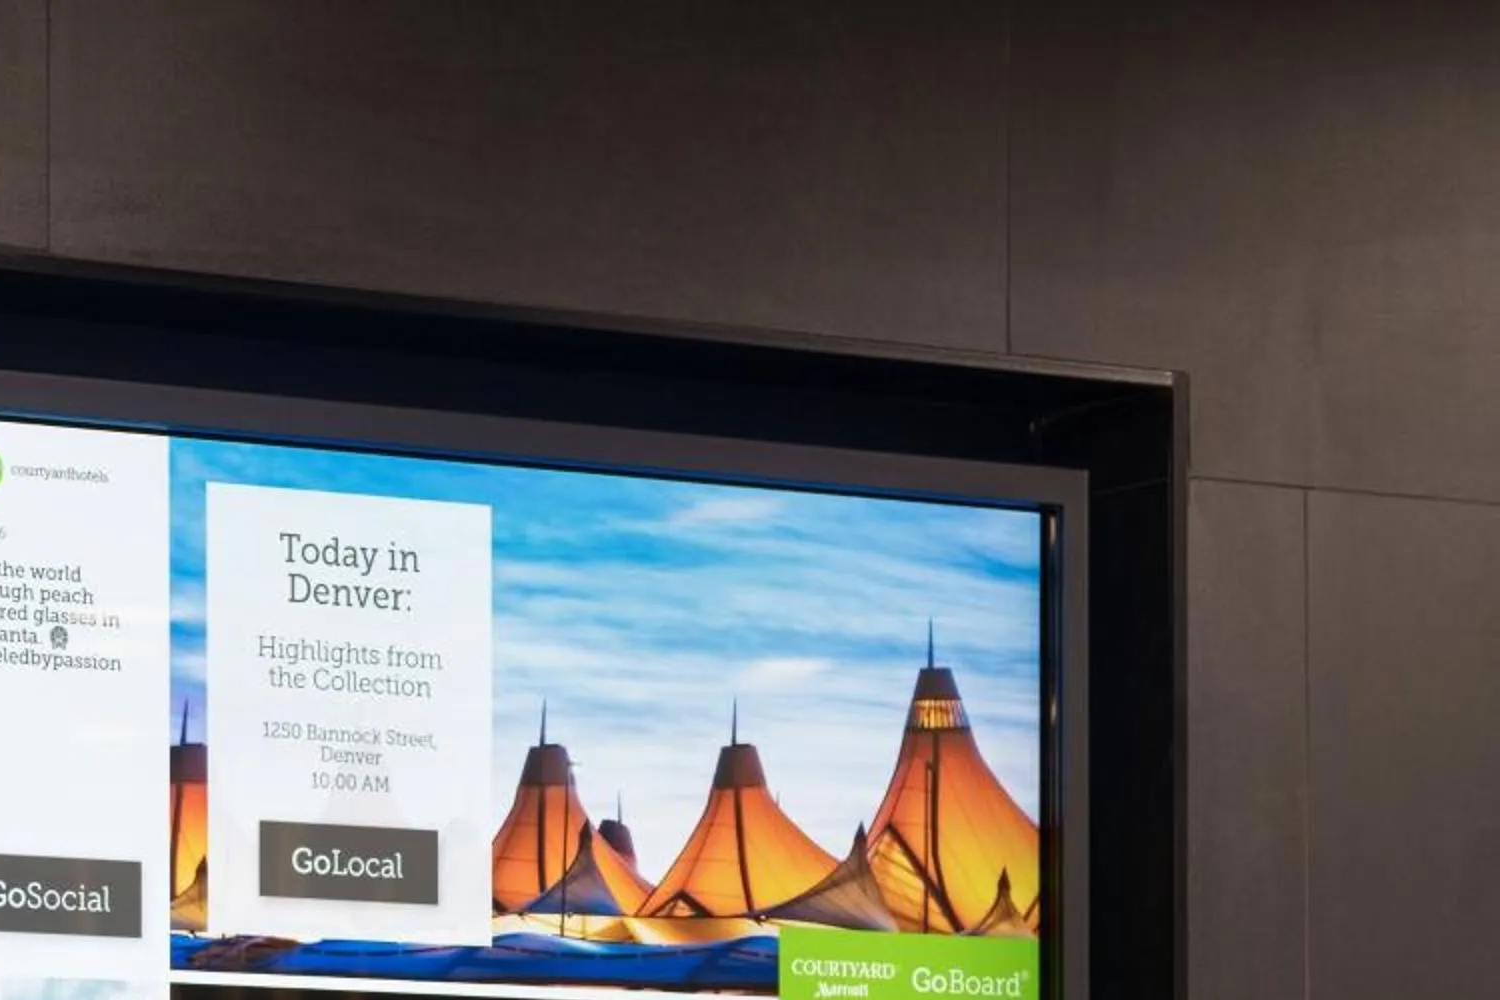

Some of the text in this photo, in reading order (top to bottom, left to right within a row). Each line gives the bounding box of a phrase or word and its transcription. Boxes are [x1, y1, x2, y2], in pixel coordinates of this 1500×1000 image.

[280, 532, 420, 576] Today in
[30, 565, 82, 583] world
[39, 587, 94, 605] peach
[288, 573, 412, 612] Denver:
[33, 607, 97, 627] glasses
[102, 612, 120, 628] in
[258, 635, 443, 671] Highlights from
[269, 667, 432, 698] the Collection
[262, 721, 437, 751] 1250 Bannock Street,
[321, 745, 383, 766] Denver
[362, 774, 390, 793] AM
[291, 845, 404, 880] GoLocal
[791, 958, 896, 980] COURTYARD
